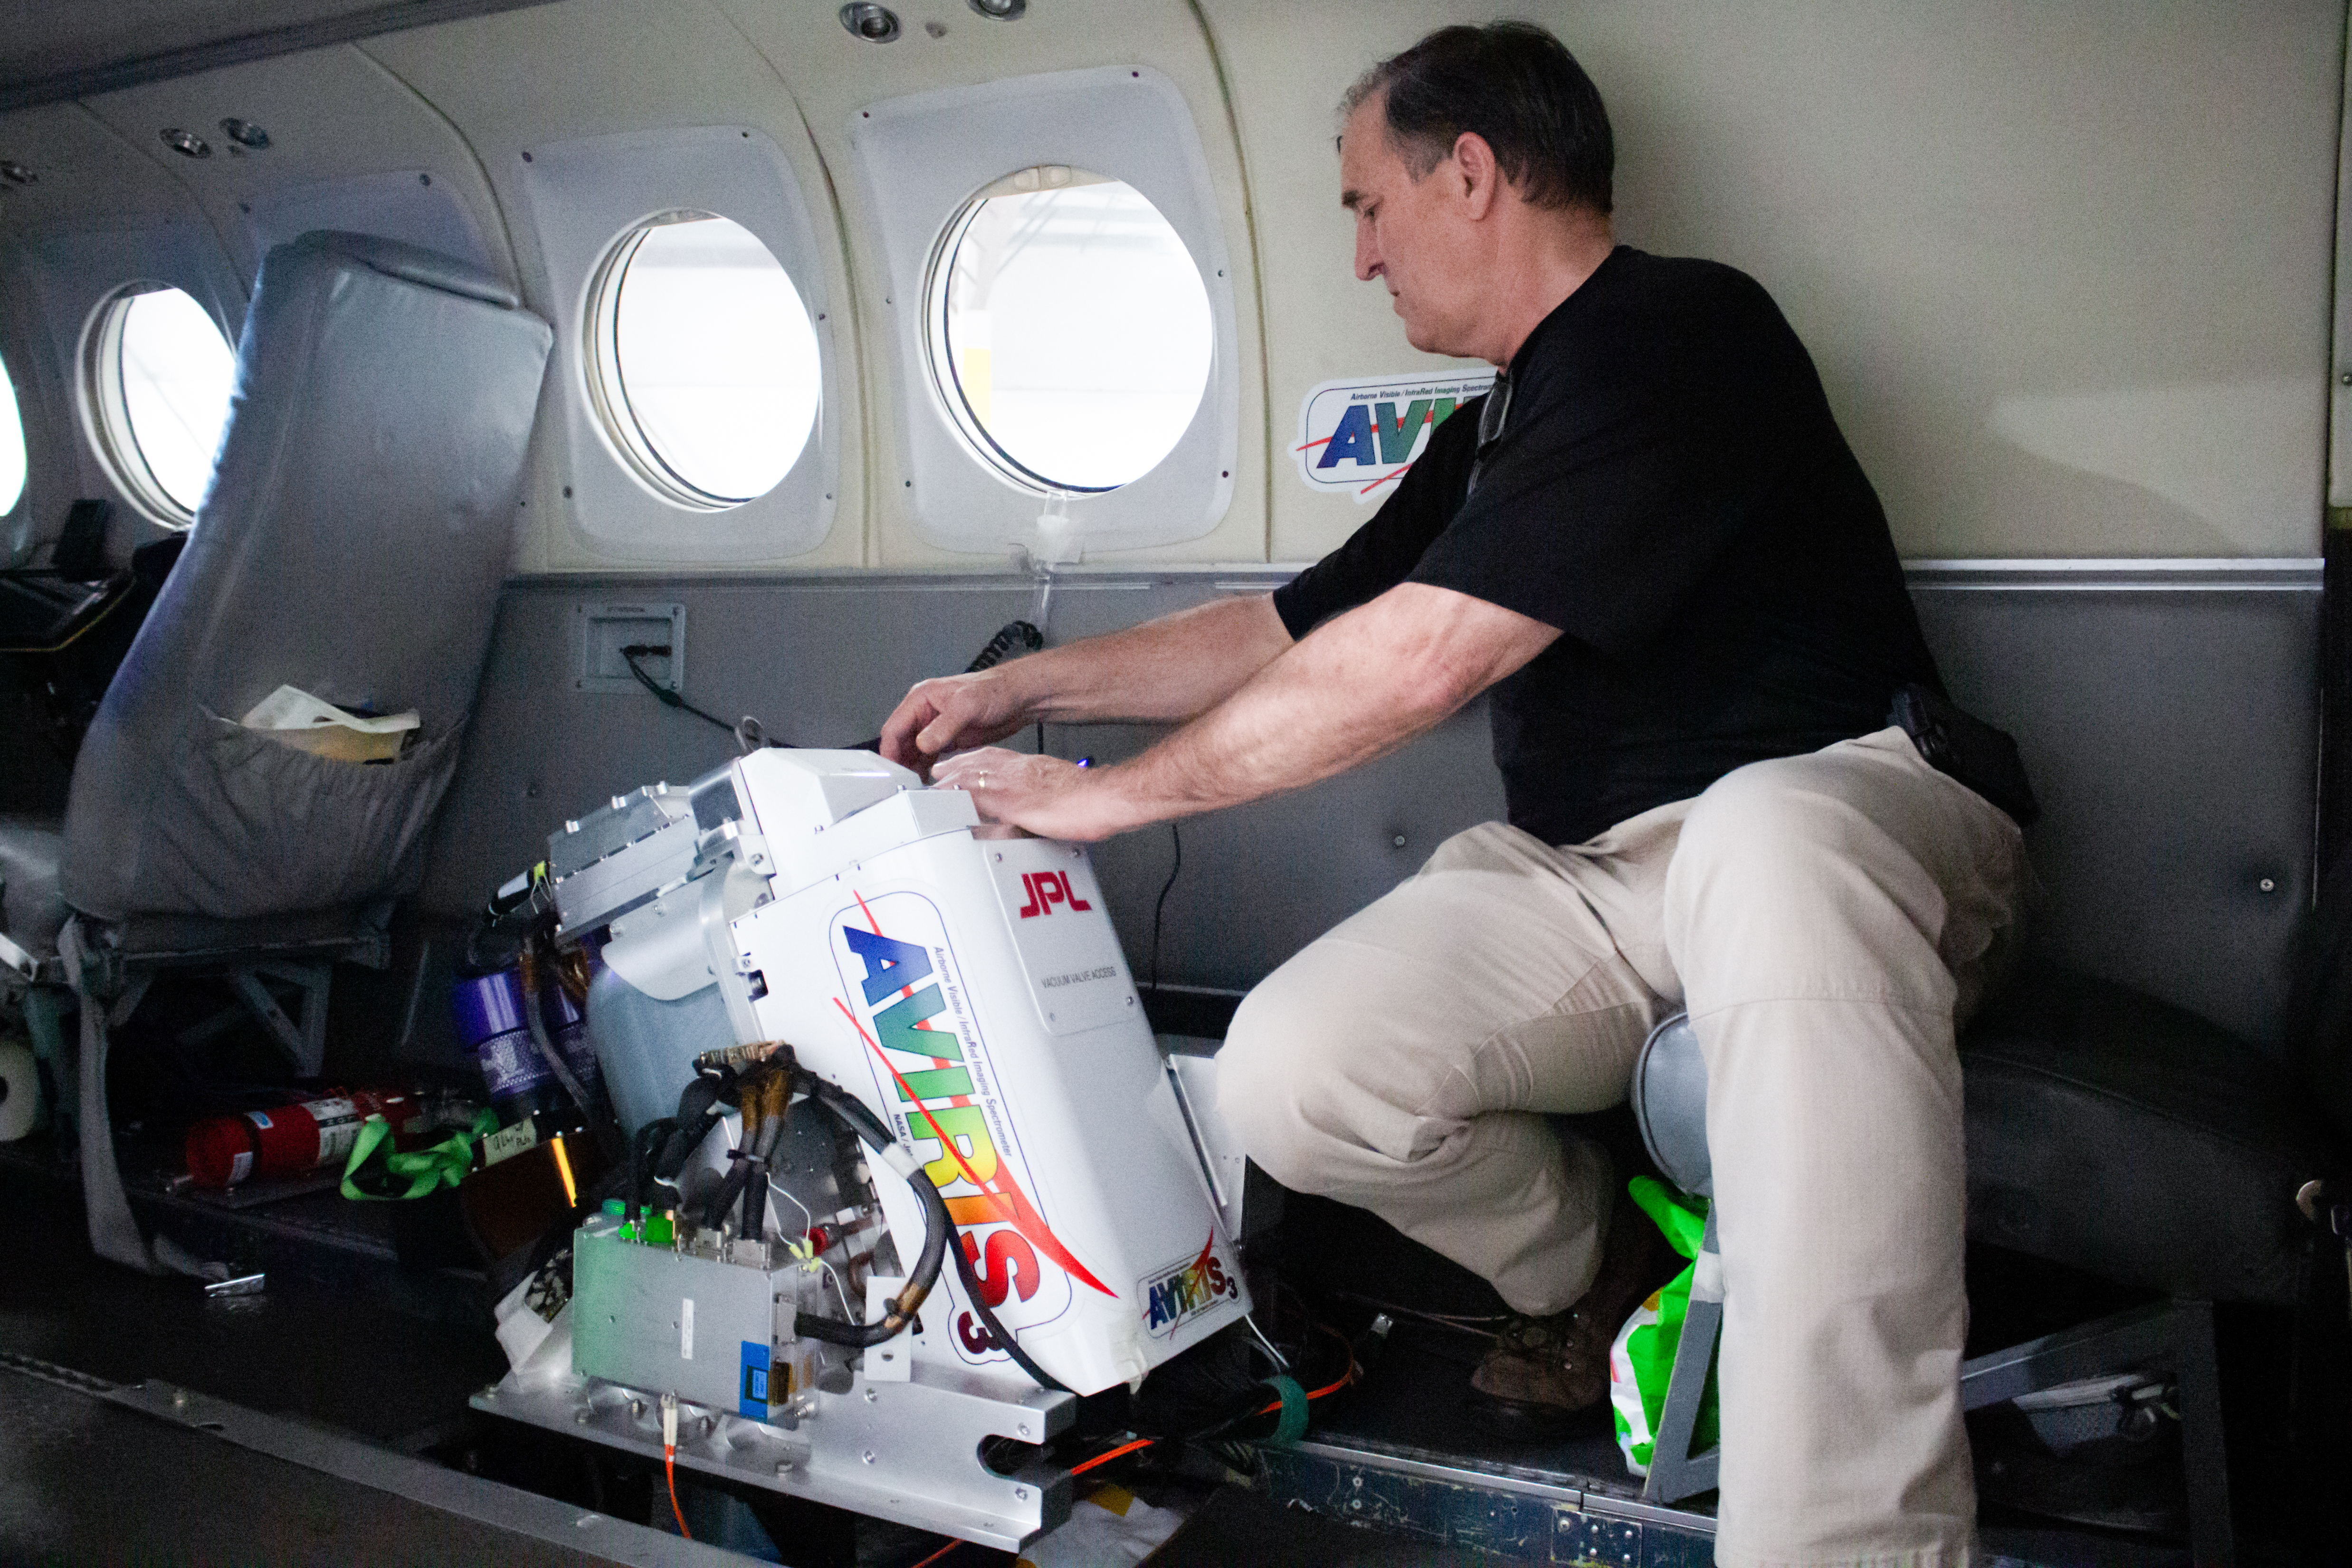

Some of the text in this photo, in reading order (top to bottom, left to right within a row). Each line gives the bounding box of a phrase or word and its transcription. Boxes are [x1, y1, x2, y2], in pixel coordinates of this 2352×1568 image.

[1405, 388, 1433, 396] InfraRed
[1435, 386, 1460, 395] Imaging
[1020, 870, 1092, 919] JPL
[1041, 966, 1116, 988] VACUUM VALVE ACCESS
[933, 946, 952, 983] Airborne
[947, 986, 962, 1015] Visible
[959, 1021, 979, 1058] InfraRed
[973, 1061, 990, 1096] Imaging
[986, 1098, 1012, 1157] Spectrometer
[842, 925, 1040, 1309] AVIRIS
[894, 1114, 907, 1138] NASA
[1149, 1256, 1226, 1330] AVIRIS
[1227, 1276, 1238, 1300] 3
